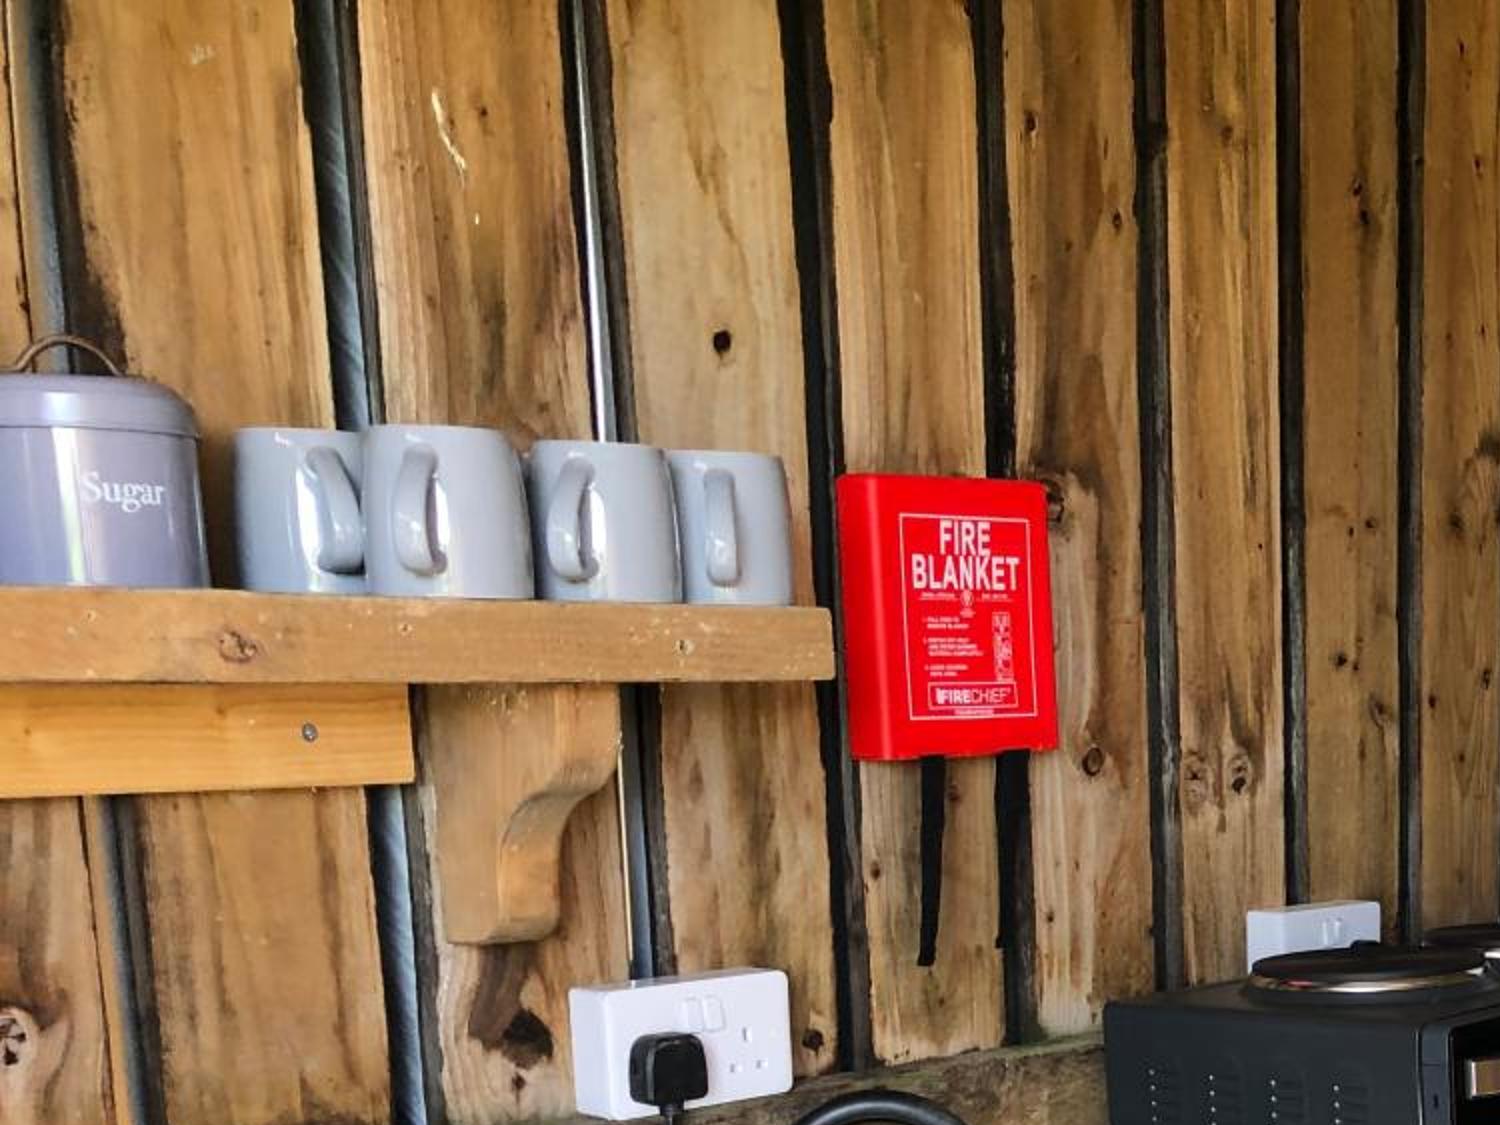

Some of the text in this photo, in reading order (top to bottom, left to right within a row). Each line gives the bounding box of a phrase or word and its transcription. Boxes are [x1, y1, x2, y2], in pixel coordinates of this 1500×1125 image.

[81, 471, 164, 512] Sugar
[939, 519, 991, 556] FIRE
[911, 553, 1019, 591] BLANKET
